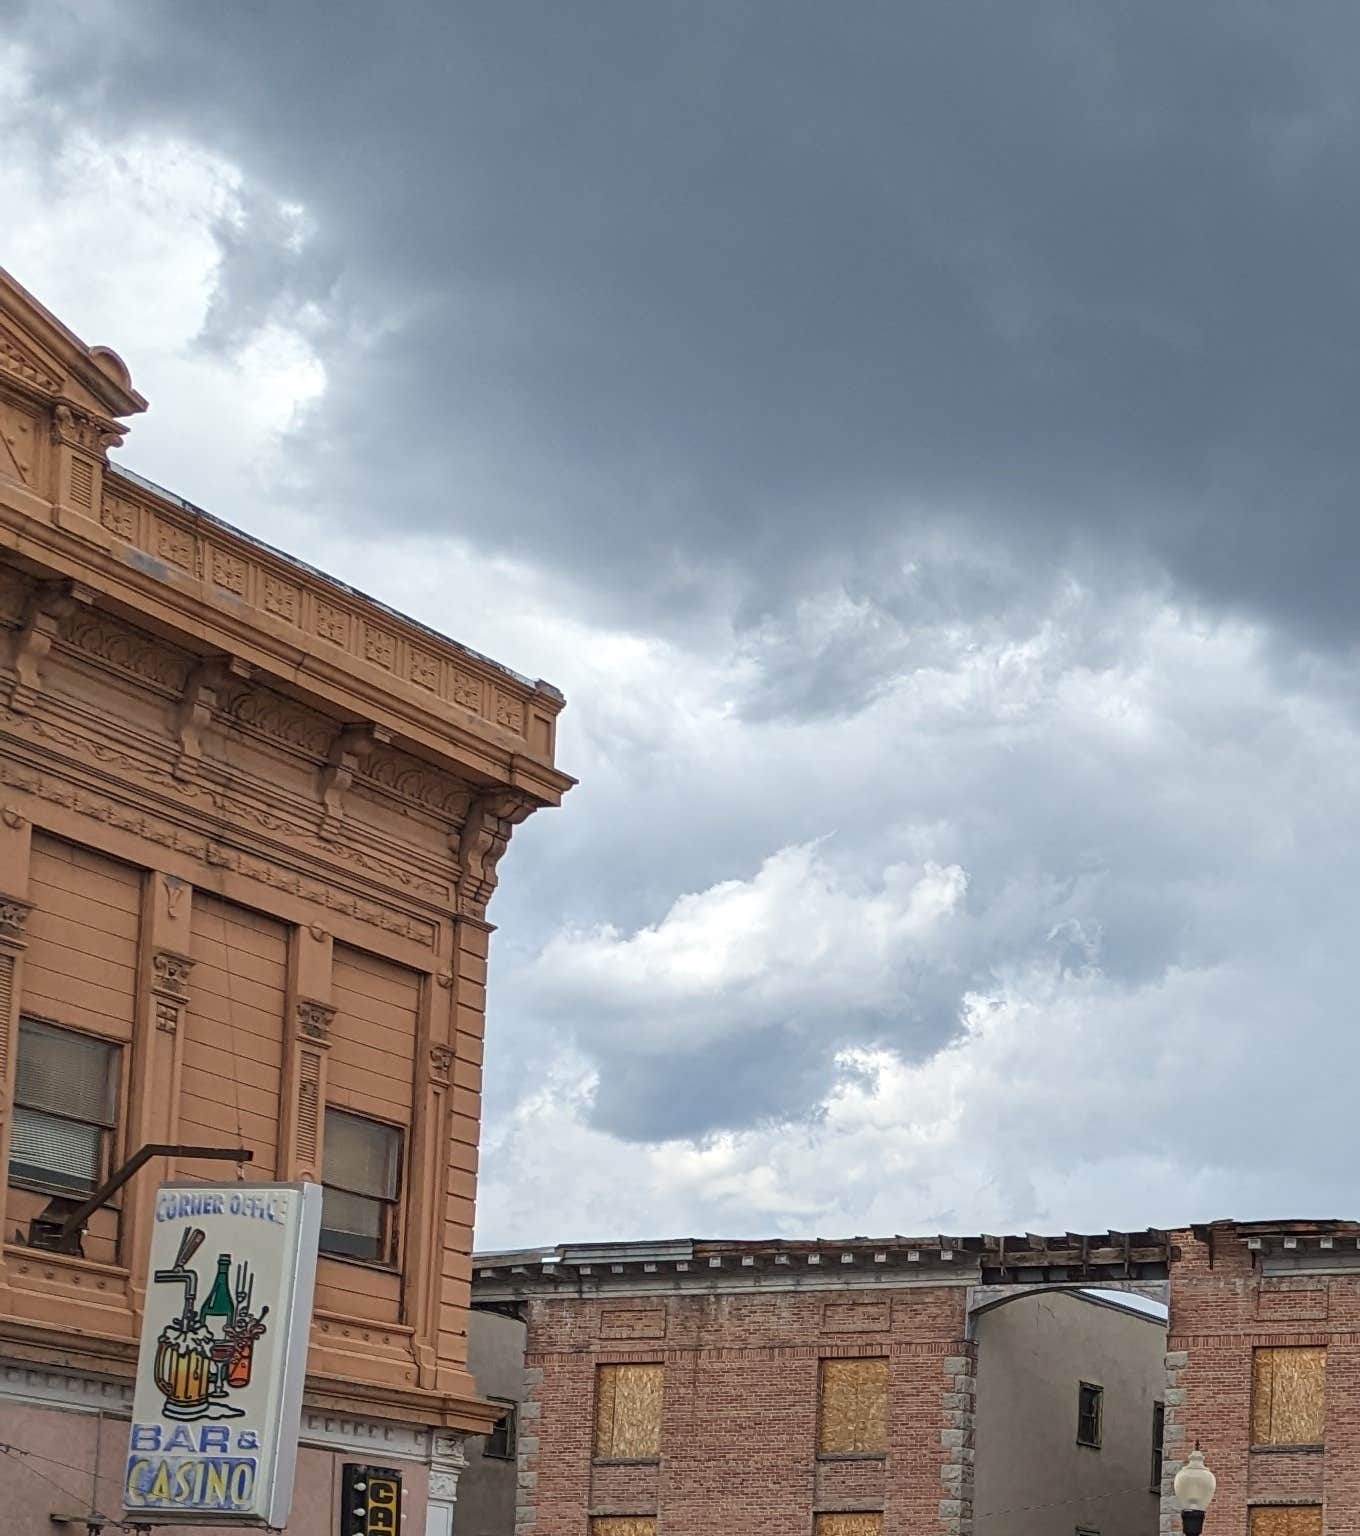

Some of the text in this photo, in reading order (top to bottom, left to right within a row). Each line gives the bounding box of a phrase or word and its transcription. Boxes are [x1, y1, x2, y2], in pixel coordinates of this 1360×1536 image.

[156, 1193, 225, 1222] CORNER
[131, 1424, 259, 1453] BAR &
[126, 1457, 255, 1506] CASINO
